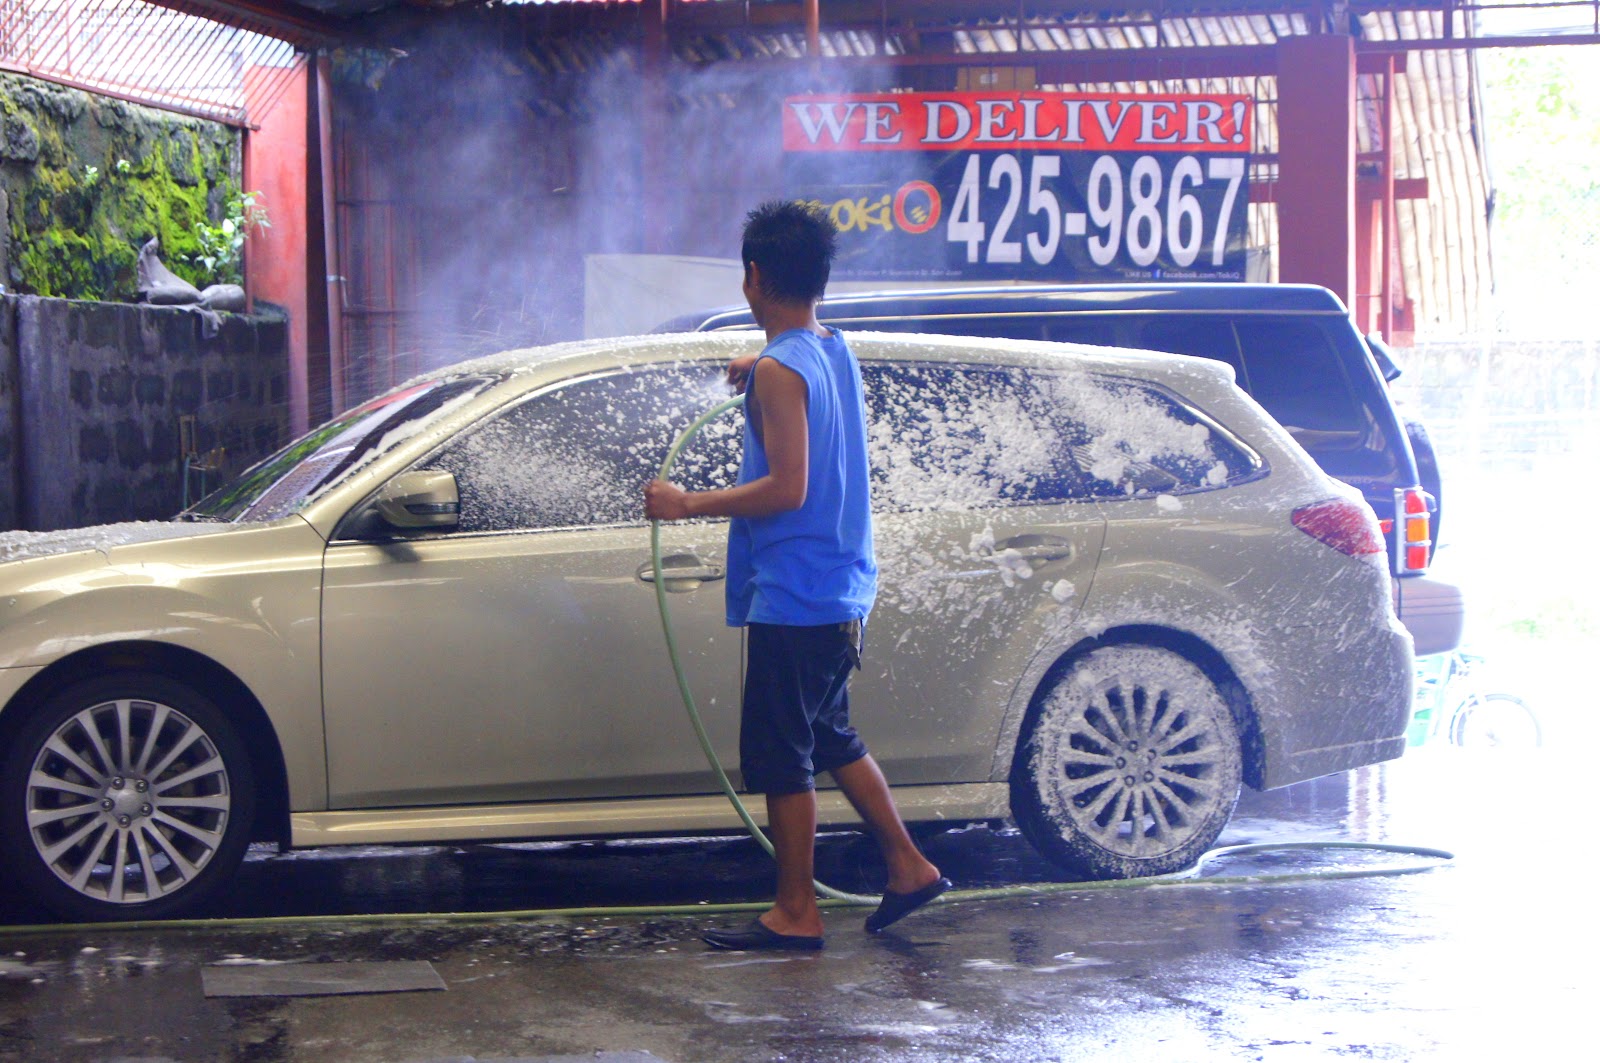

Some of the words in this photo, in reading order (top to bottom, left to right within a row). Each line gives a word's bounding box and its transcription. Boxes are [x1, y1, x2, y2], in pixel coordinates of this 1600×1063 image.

[789, 101, 903, 144] WE
[919, 99, 1246, 144] DELIVER!
[946, 153, 1245, 267] 425-9867
